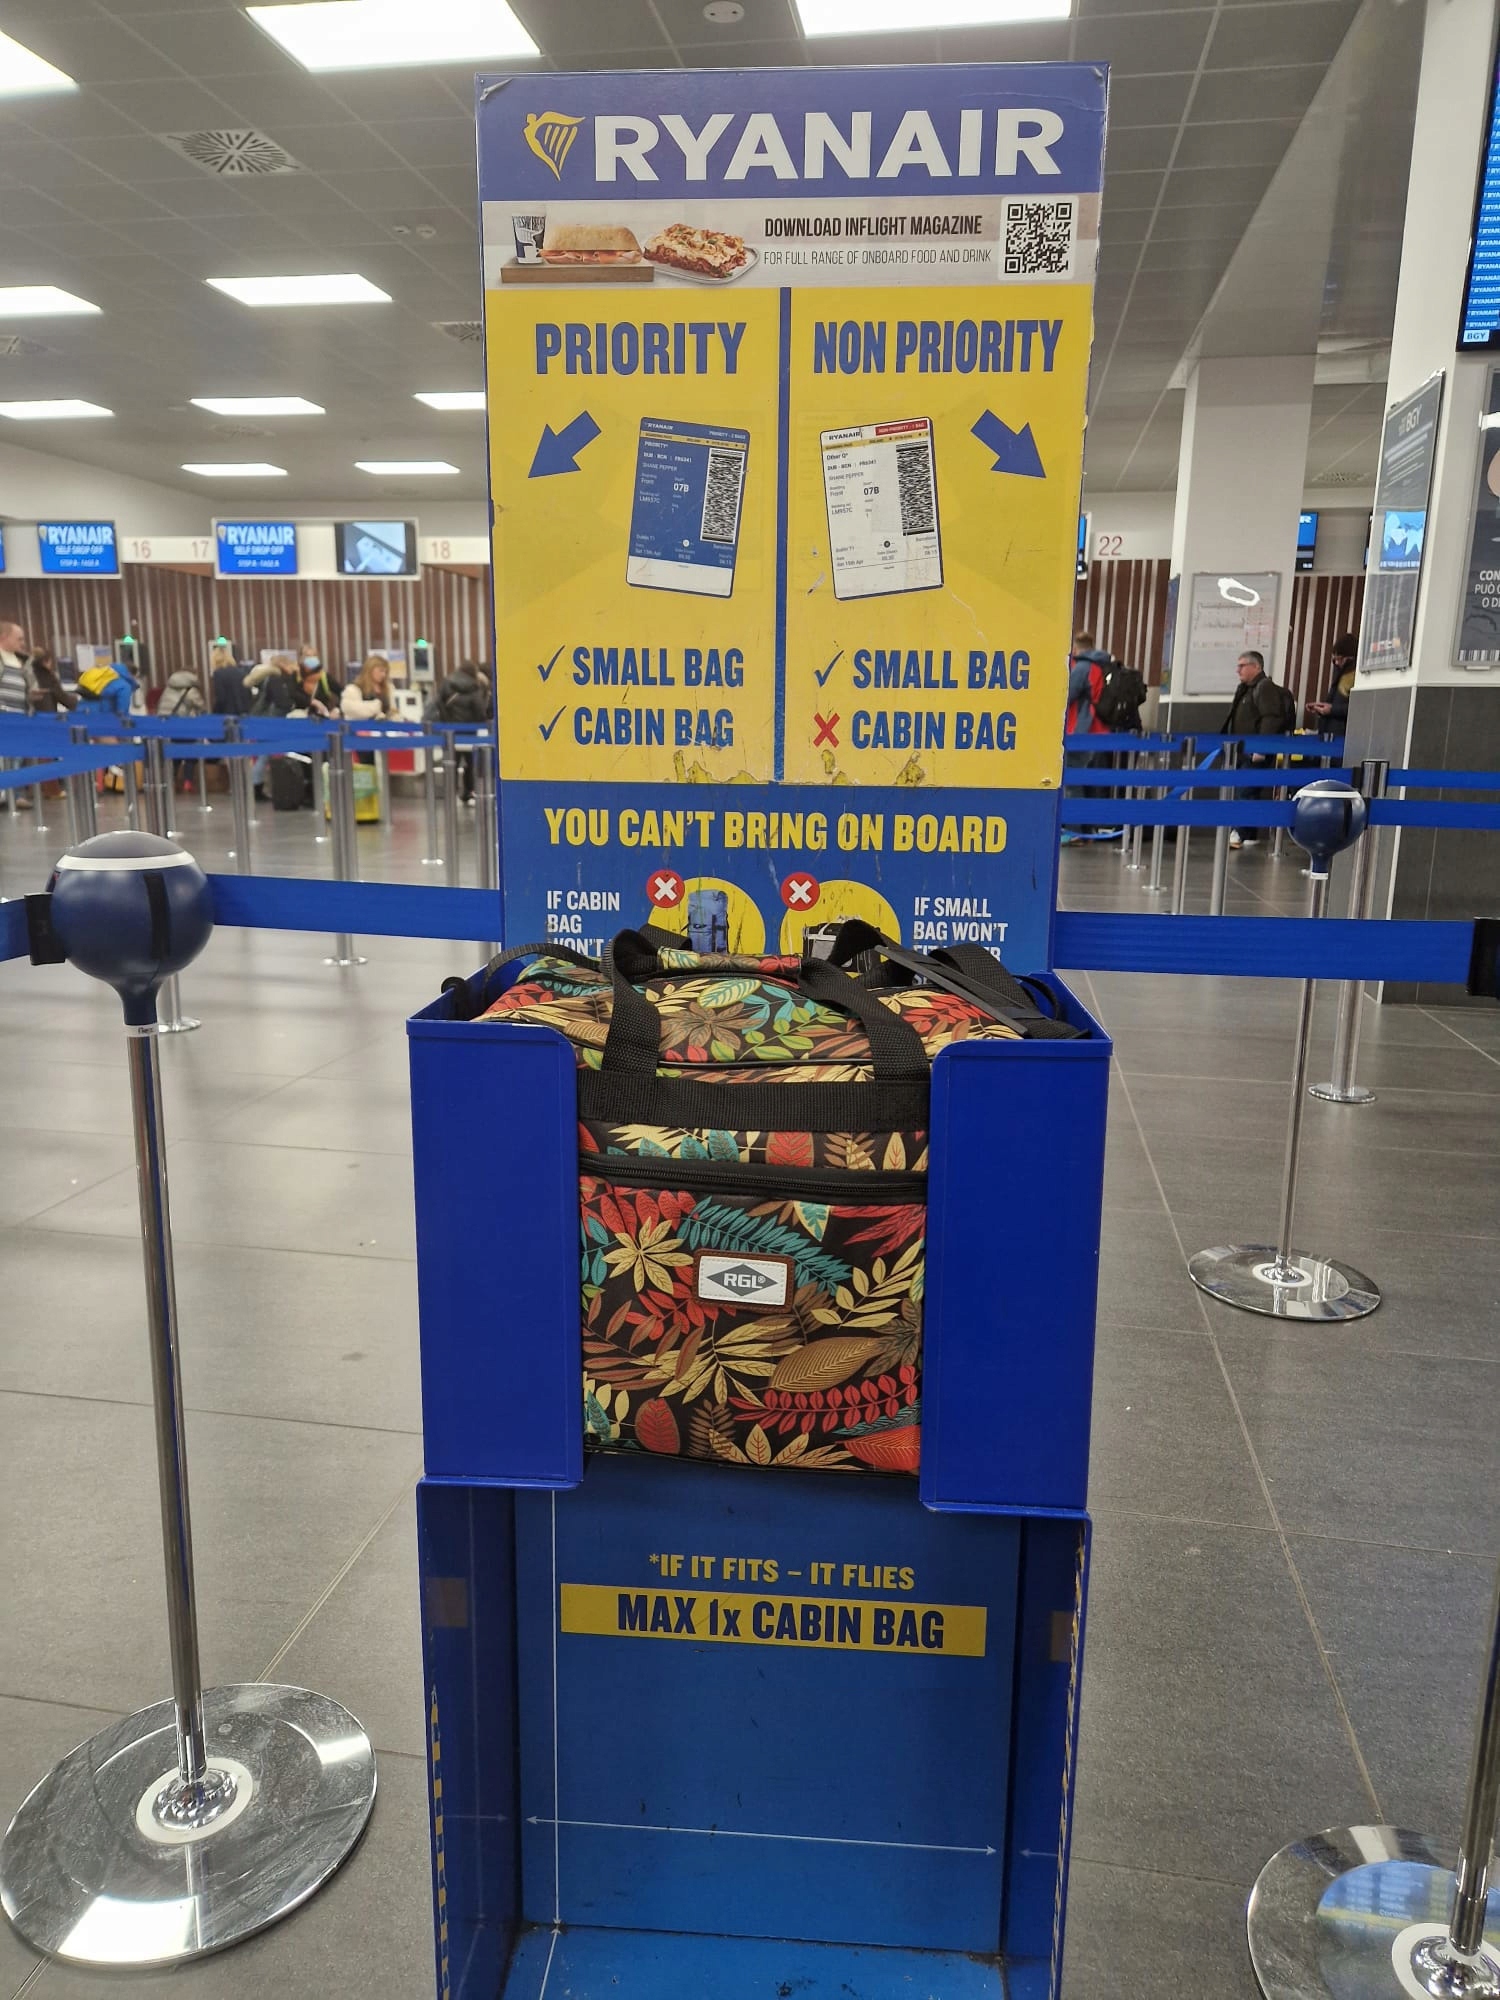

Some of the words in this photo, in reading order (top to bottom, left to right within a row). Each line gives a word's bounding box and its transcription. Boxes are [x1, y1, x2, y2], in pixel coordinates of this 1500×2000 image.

[594, 108, 1065, 182] RYANAIR
[764, 217, 842, 237] DOWNLOAD
[845, 216, 907, 236] INFLIGHT
[910, 215, 983, 235] MAGAZINE
[763, 251, 783, 265] FOR
[785, 251, 809, 265] FULL
[811, 251, 844, 265] RANGE
[847, 250, 860, 265] OF
[862, 250, 909, 264] ONBOARD
[911, 249, 937, 264] FOOD
[939, 249, 961, 263] AND
[963, 248, 992, 263] DRINK
[1467, 332, 1486, 340] BGY
[535, 321, 747, 375] PRIORITY
[814, 320, 887, 375] NON
[896, 319, 1063, 374] PRIORITY
[828, 430, 861, 441] RYANAIR
[673, 483, 690, 493] 07B
[863, 486, 880, 496] 07B
[48, 526, 114, 546] RYANAIR
[227, 525, 295, 546] RYANAIR
[1098, 535, 1123, 556] 22
[132, 540, 152, 559] 16
[191, 540, 210, 558] 17
[431, 540, 450, 560] 18
[1474, 582, 1495, 595] PUÒ
[1481, 597, 1489, 608] O
[572, 646, 675, 687] SMALL
[684, 648, 744, 688] BAG
[853, 649, 958, 690] SMALL
[968, 650, 1031, 690] BAG
[573, 706, 665, 746] CABIN
[674, 707, 734, 747] BAG
[852, 710, 948, 751] CABIN
[957, 711, 1017, 751] BAG
[544, 807, 609, 846] YOU
[618, 809, 716, 848] CAN'T
[724, 811, 828, 850] BRING
[837, 813, 884, 851] ON
[893, 814, 1008, 853] BOARD
[547, 890, 563, 910] IF
[566, 890, 620, 911] CABIN
[914, 896, 931, 916] IF
[933, 897, 992, 918] SMALL
[547, 913, 582, 934] BAG
[913, 920, 948, 941] BAG
[951, 921, 1009, 942] WON'T
[548, 937, 605, 957] ON'T
[691, 1555, 716, 1579] IT
[723, 1557, 779, 1583] FITS
[810, 1562, 836, 1586] IT
[843, 1563, 915, 1590] FLIES
[617, 1592, 697, 1634] MAX
[709, 1598, 741, 1637] 1x
[752, 1601, 862, 1645] CABIN
[873, 1608, 945, 1650] BAG
